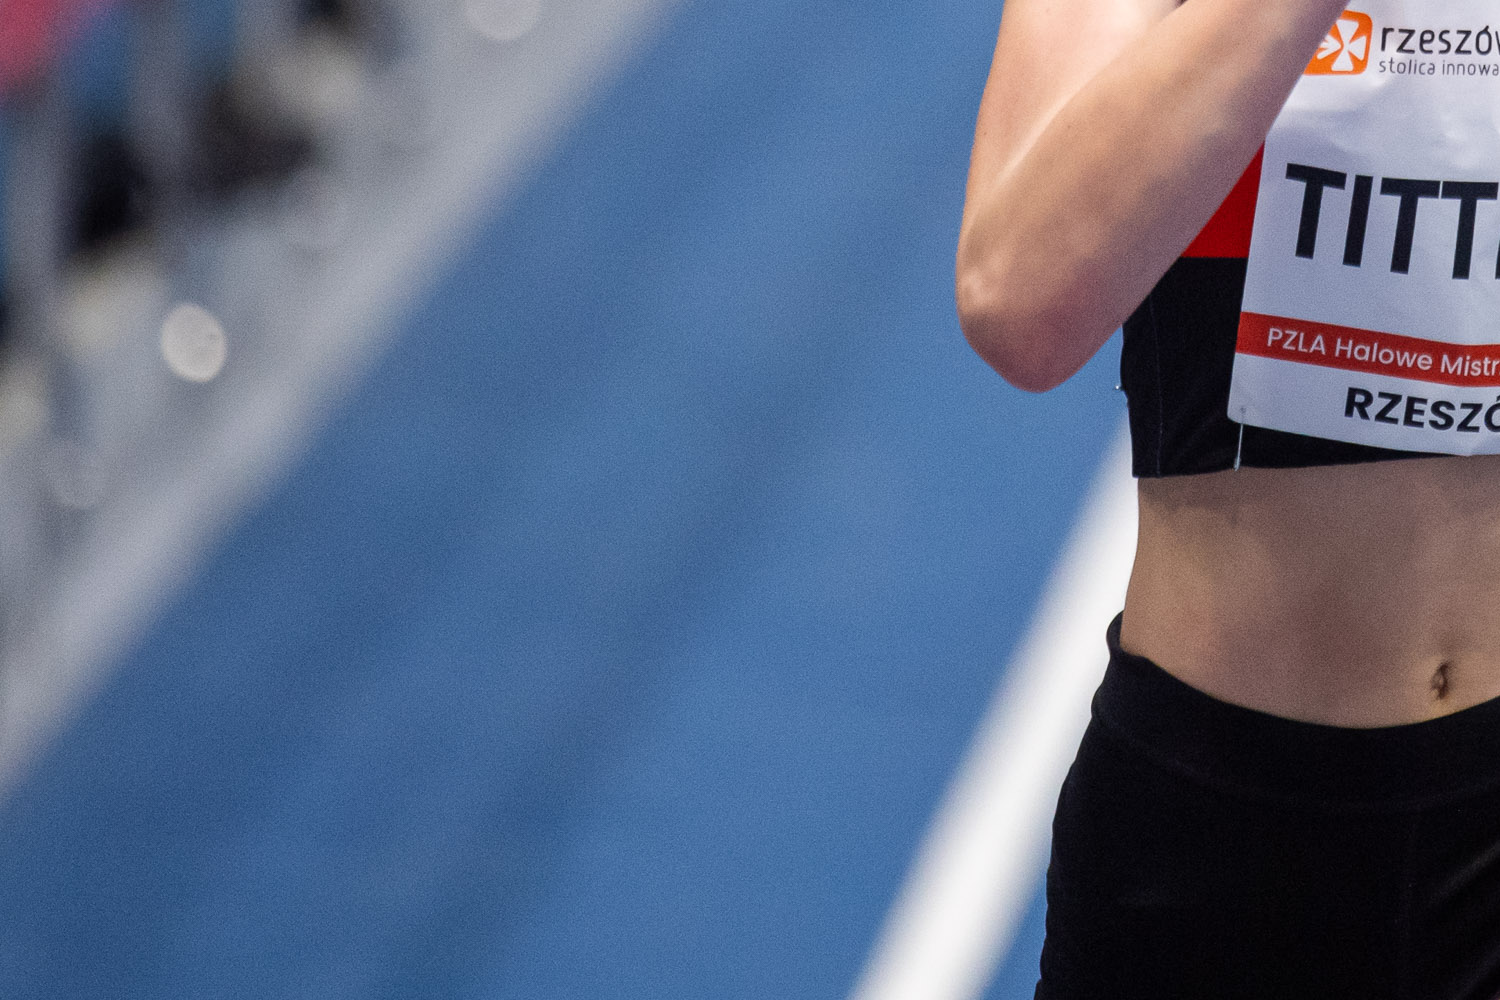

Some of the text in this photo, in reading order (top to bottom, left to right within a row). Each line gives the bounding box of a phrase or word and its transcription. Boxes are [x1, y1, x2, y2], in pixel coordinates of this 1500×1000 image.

[1379, 57, 1436, 76] stolica
[1267, 327, 1326, 355] PZLA
[1335, 337, 1433, 371] Halowe
